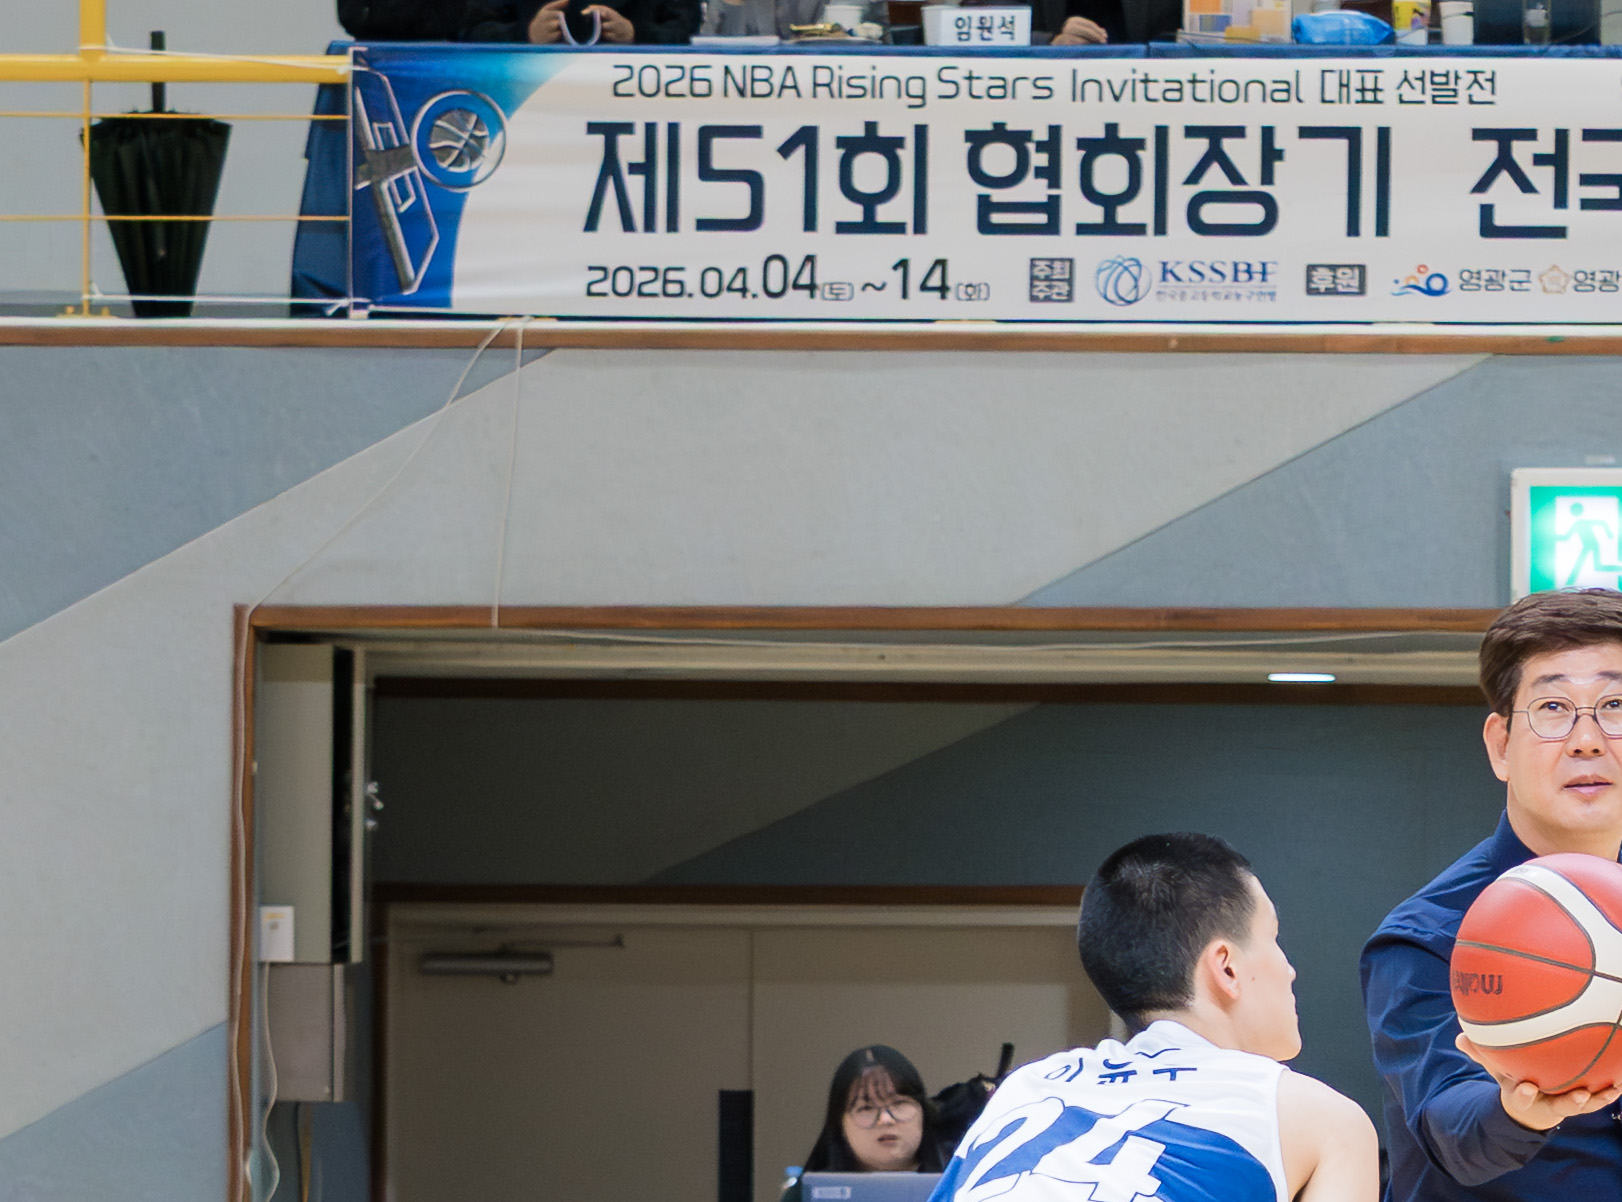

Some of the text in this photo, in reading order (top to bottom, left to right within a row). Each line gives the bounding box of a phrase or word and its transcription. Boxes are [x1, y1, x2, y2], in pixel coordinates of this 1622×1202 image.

[954, 15, 1016, 42] 임원석
[612, 65, 1498, 108] 2026 NBA Rising Stars Invitational 대표 선발전
[583, 121, 929, 236] 제51회
[964, 122, 1392, 238] 협회장기
[1310, 266, 1360, 293] 후원
[1458, 268, 1532, 292] 영광군
